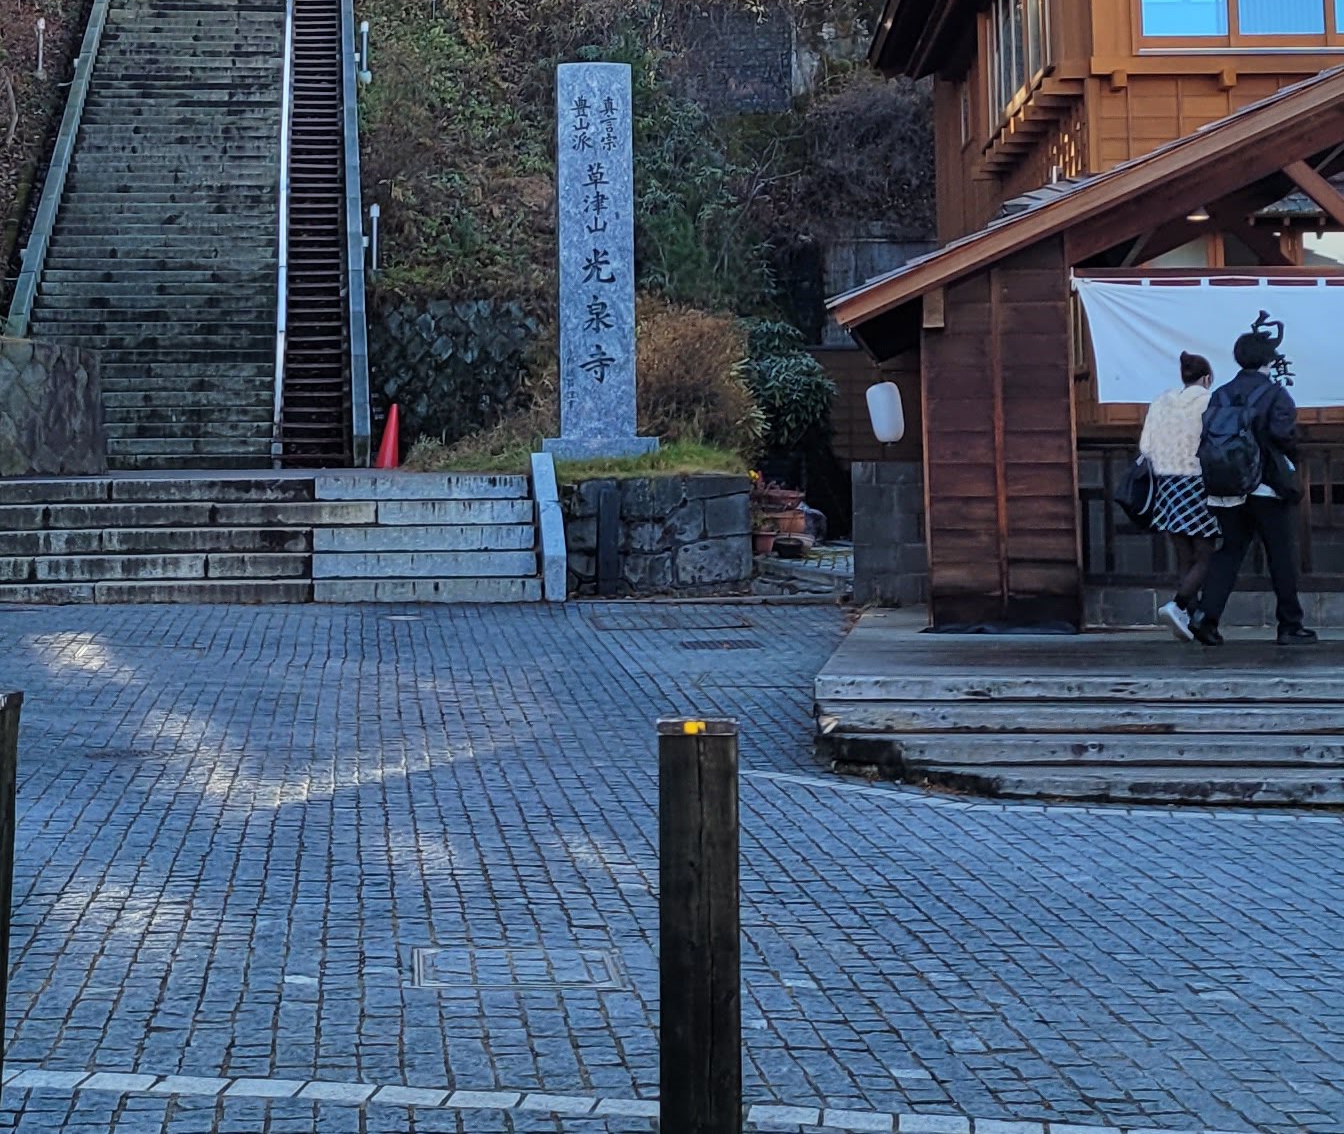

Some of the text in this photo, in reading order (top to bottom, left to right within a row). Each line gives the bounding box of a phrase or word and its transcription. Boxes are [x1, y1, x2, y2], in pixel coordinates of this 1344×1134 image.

[578, 162, 617, 384] 草津山光泉寺
